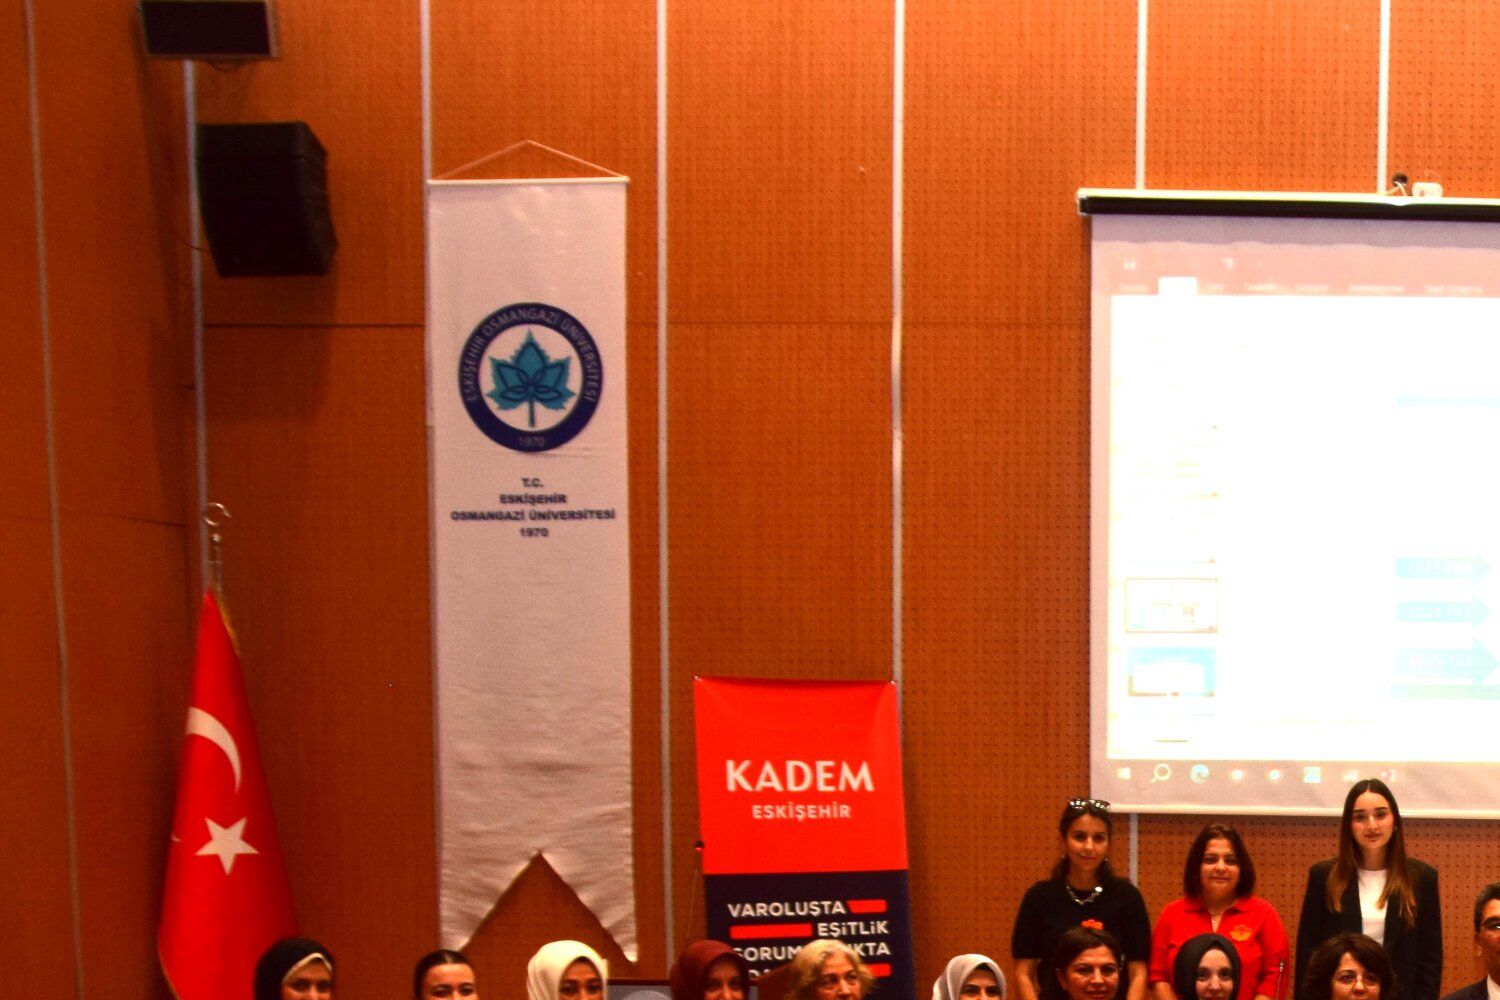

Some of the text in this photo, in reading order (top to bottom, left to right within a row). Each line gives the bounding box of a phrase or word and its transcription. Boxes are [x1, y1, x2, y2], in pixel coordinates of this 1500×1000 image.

[484, 307, 558, 338] OSMANGAZİ
[518, 435, 546, 448] 1970
[521, 478, 544, 489] T.C.
[498, 492, 568, 506] ESKİŞEHİR
[450, 507, 616, 521] OSMANGAZİ ÜNİVERSİTESİ
[519, 527, 549, 538] 1970
[725, 759, 875, 793] KADEM
[751, 802, 852, 822] ESKİŞEHİR
[727, 901, 847, 918] VAROLUŞTA
